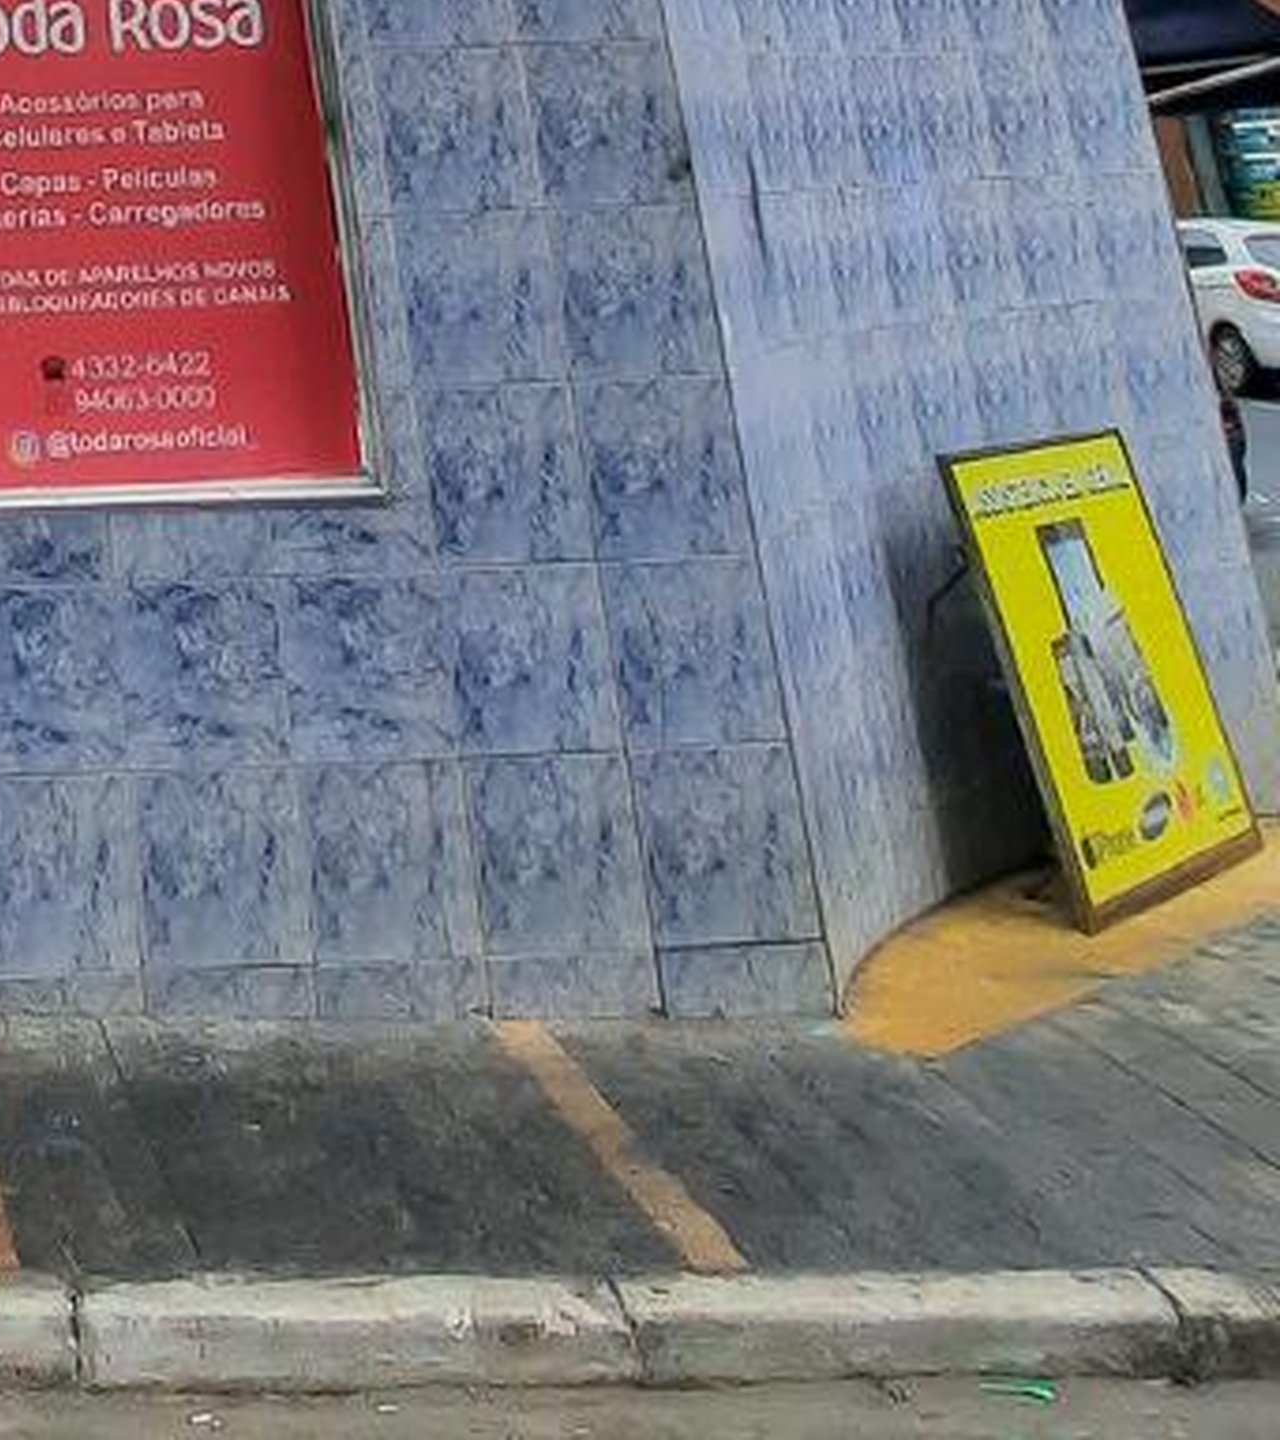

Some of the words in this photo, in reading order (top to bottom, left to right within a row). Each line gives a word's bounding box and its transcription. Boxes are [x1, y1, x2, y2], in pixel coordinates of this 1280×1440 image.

[146, 89, 205, 115] para
[133, 119, 225, 144] Tablets
[89, 200, 265, 228] Carregadores
